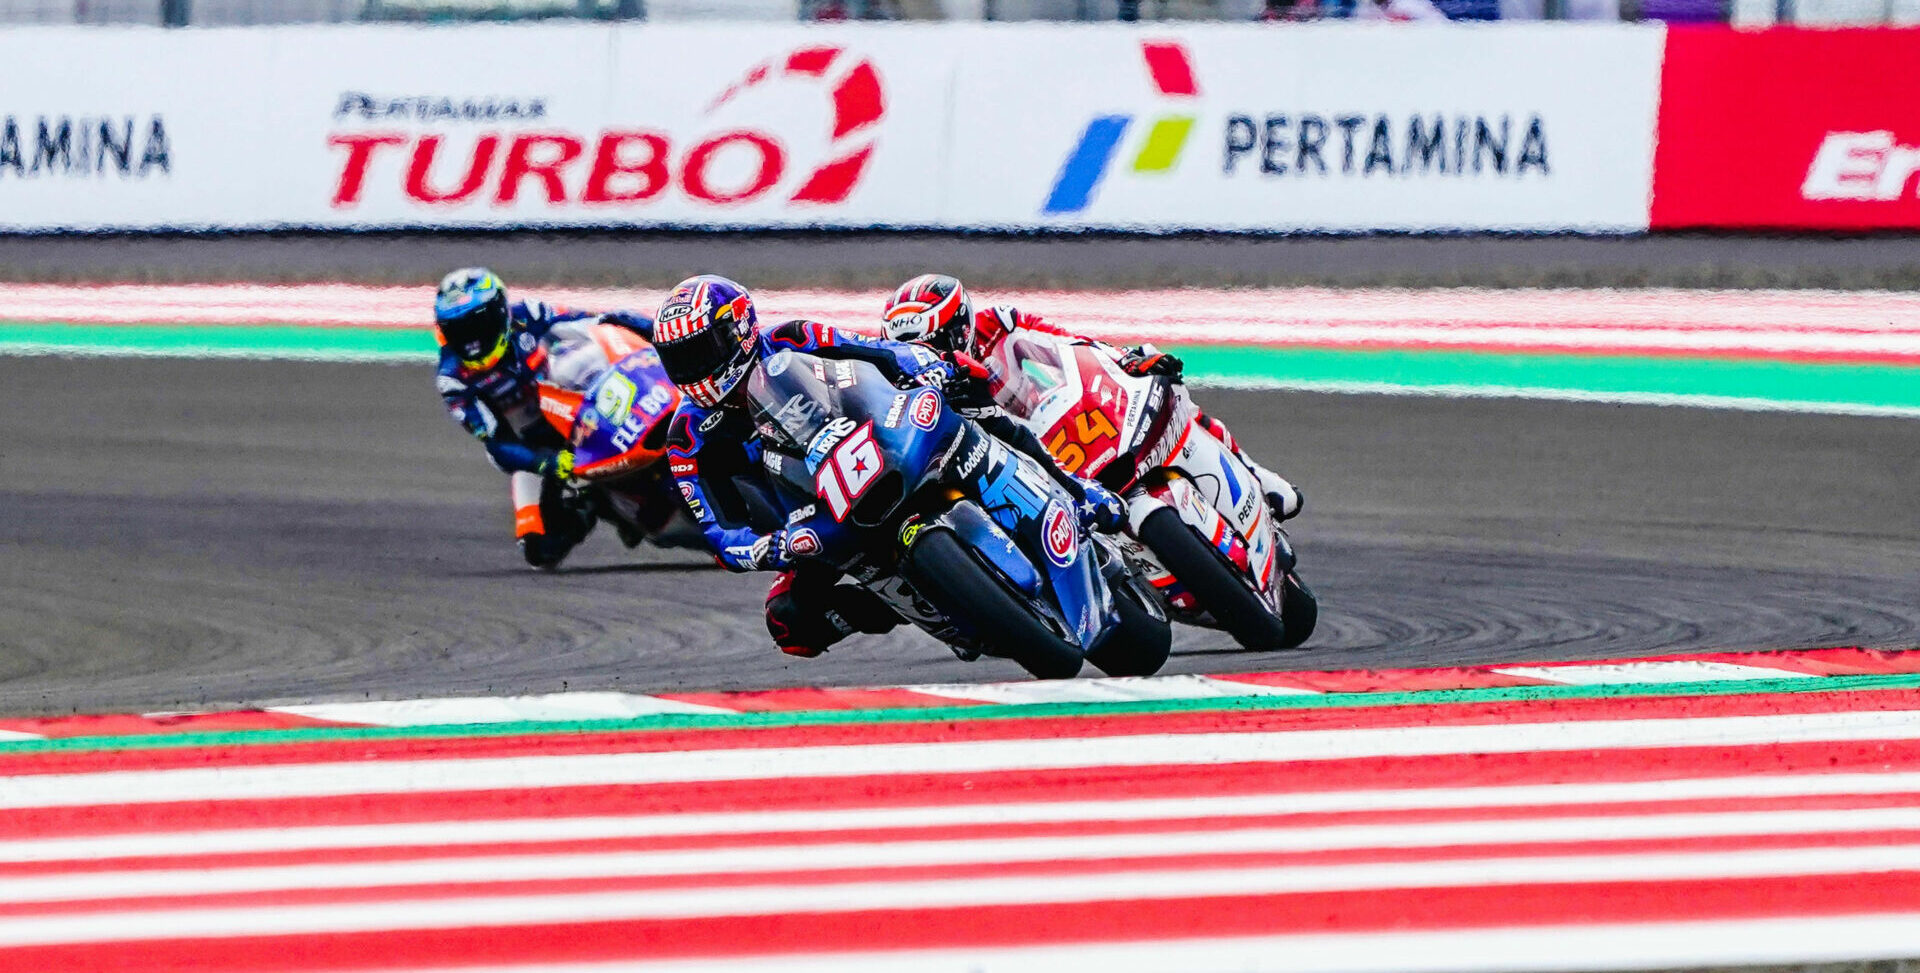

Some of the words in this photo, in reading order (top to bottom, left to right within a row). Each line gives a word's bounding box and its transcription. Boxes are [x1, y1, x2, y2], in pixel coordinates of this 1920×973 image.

[327, 132, 788, 207] TURBO
[1222, 114, 1552, 177] PERTAMINA
[596, 370, 637, 428] 9
[918, 397, 936, 424] PATA
[816, 419, 884, 523] 16
[1046, 407, 1119, 474] 54
[1051, 517, 1073, 551] PATA
